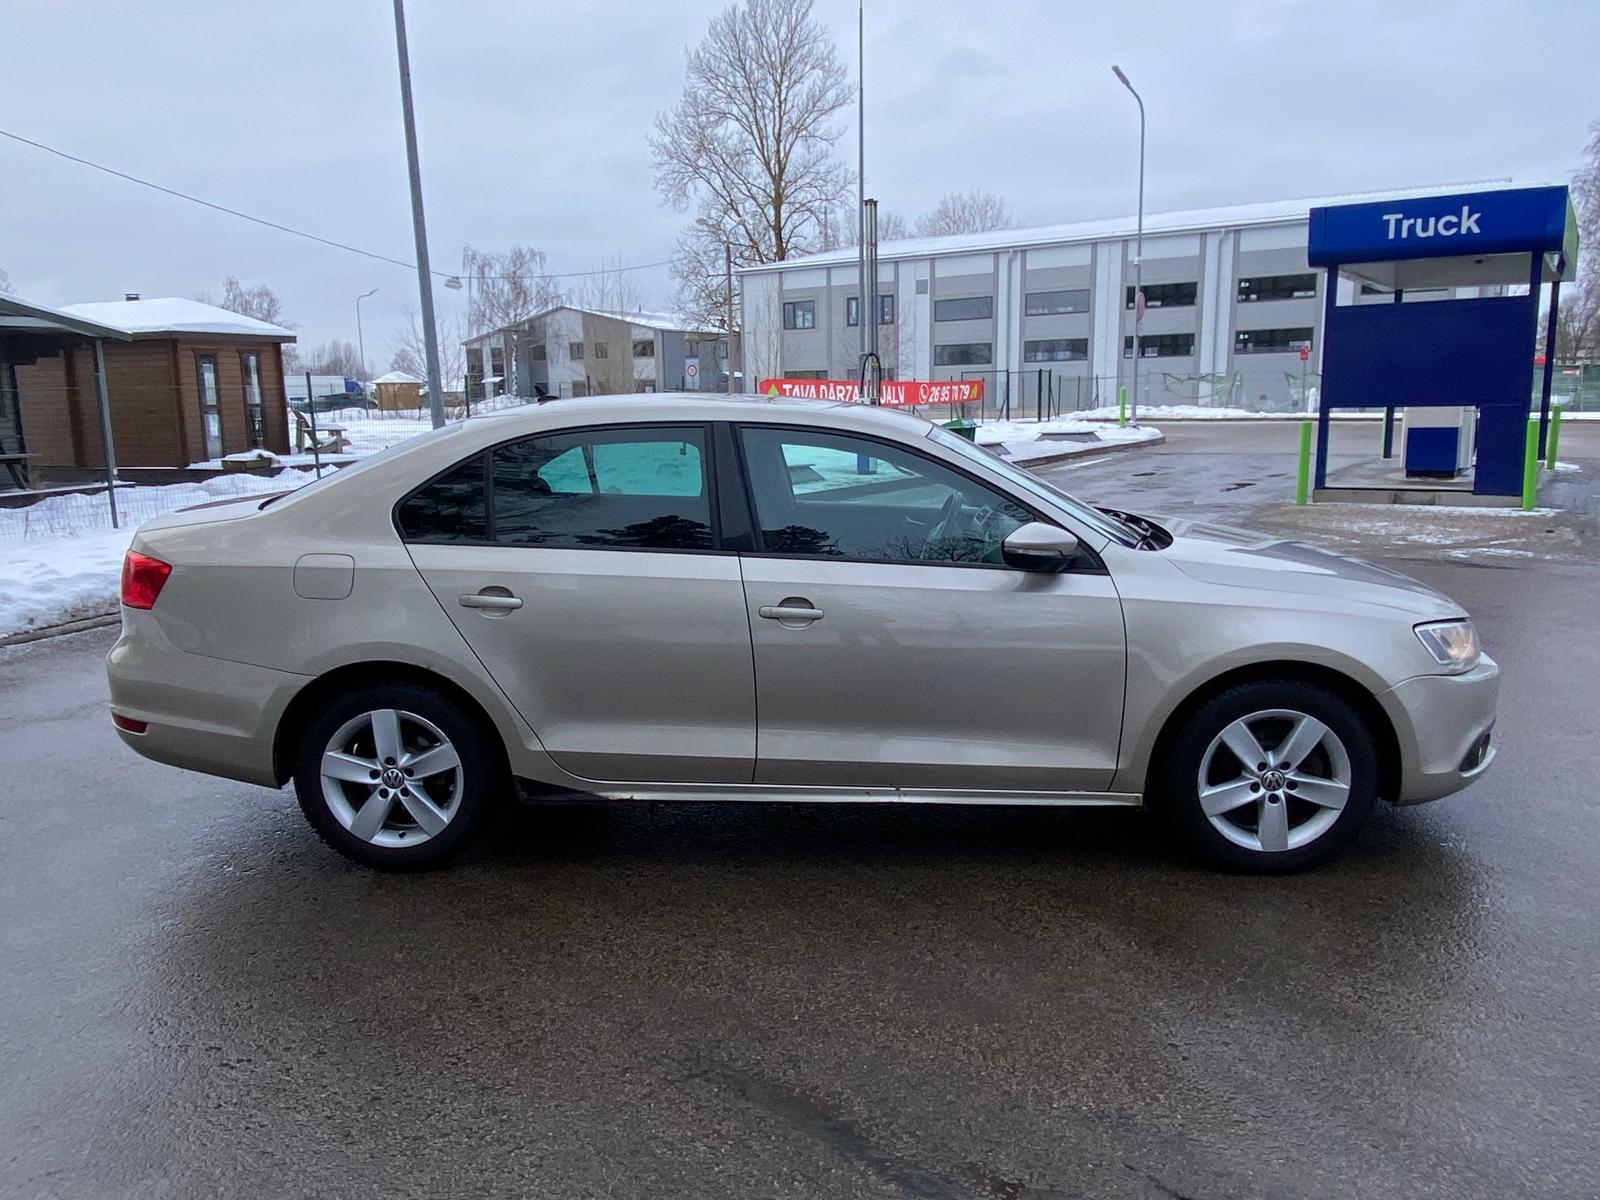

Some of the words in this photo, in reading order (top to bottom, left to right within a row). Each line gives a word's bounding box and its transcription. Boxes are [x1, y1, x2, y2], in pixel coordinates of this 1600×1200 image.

[1383, 205, 1482, 239] Truck
[928, 386, 940, 402] 26
[940, 385, 951, 401] 95
[959, 384, 970, 399] 79
